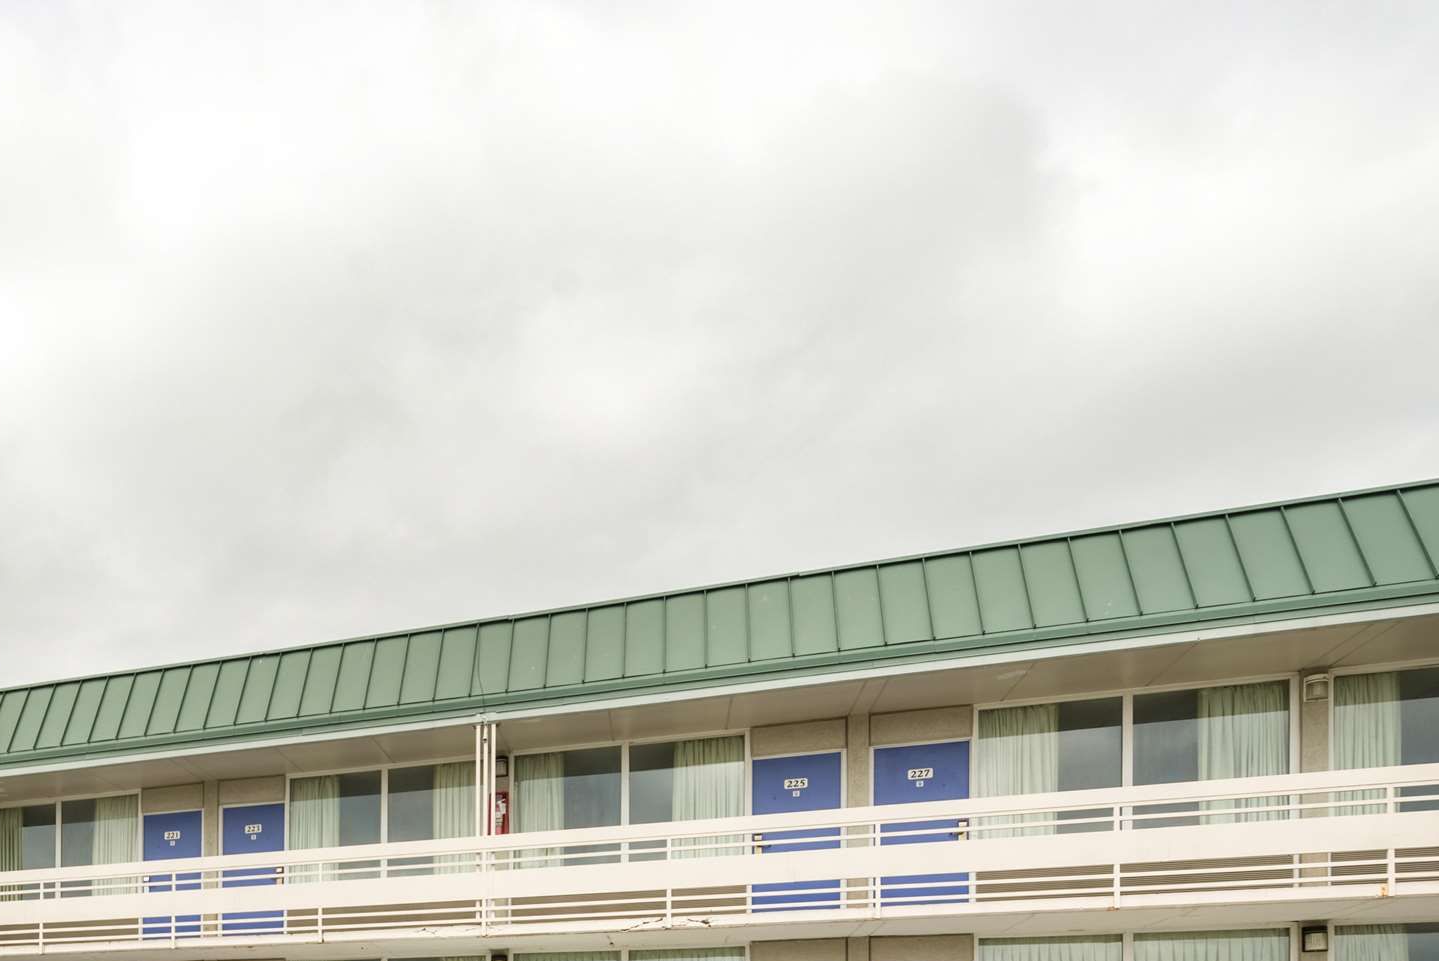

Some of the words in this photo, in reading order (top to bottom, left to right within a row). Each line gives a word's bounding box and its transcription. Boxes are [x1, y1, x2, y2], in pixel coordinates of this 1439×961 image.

[909, 768, 931, 779] 227
[785, 779, 807, 789] 225
[165, 832, 180, 840] 221
